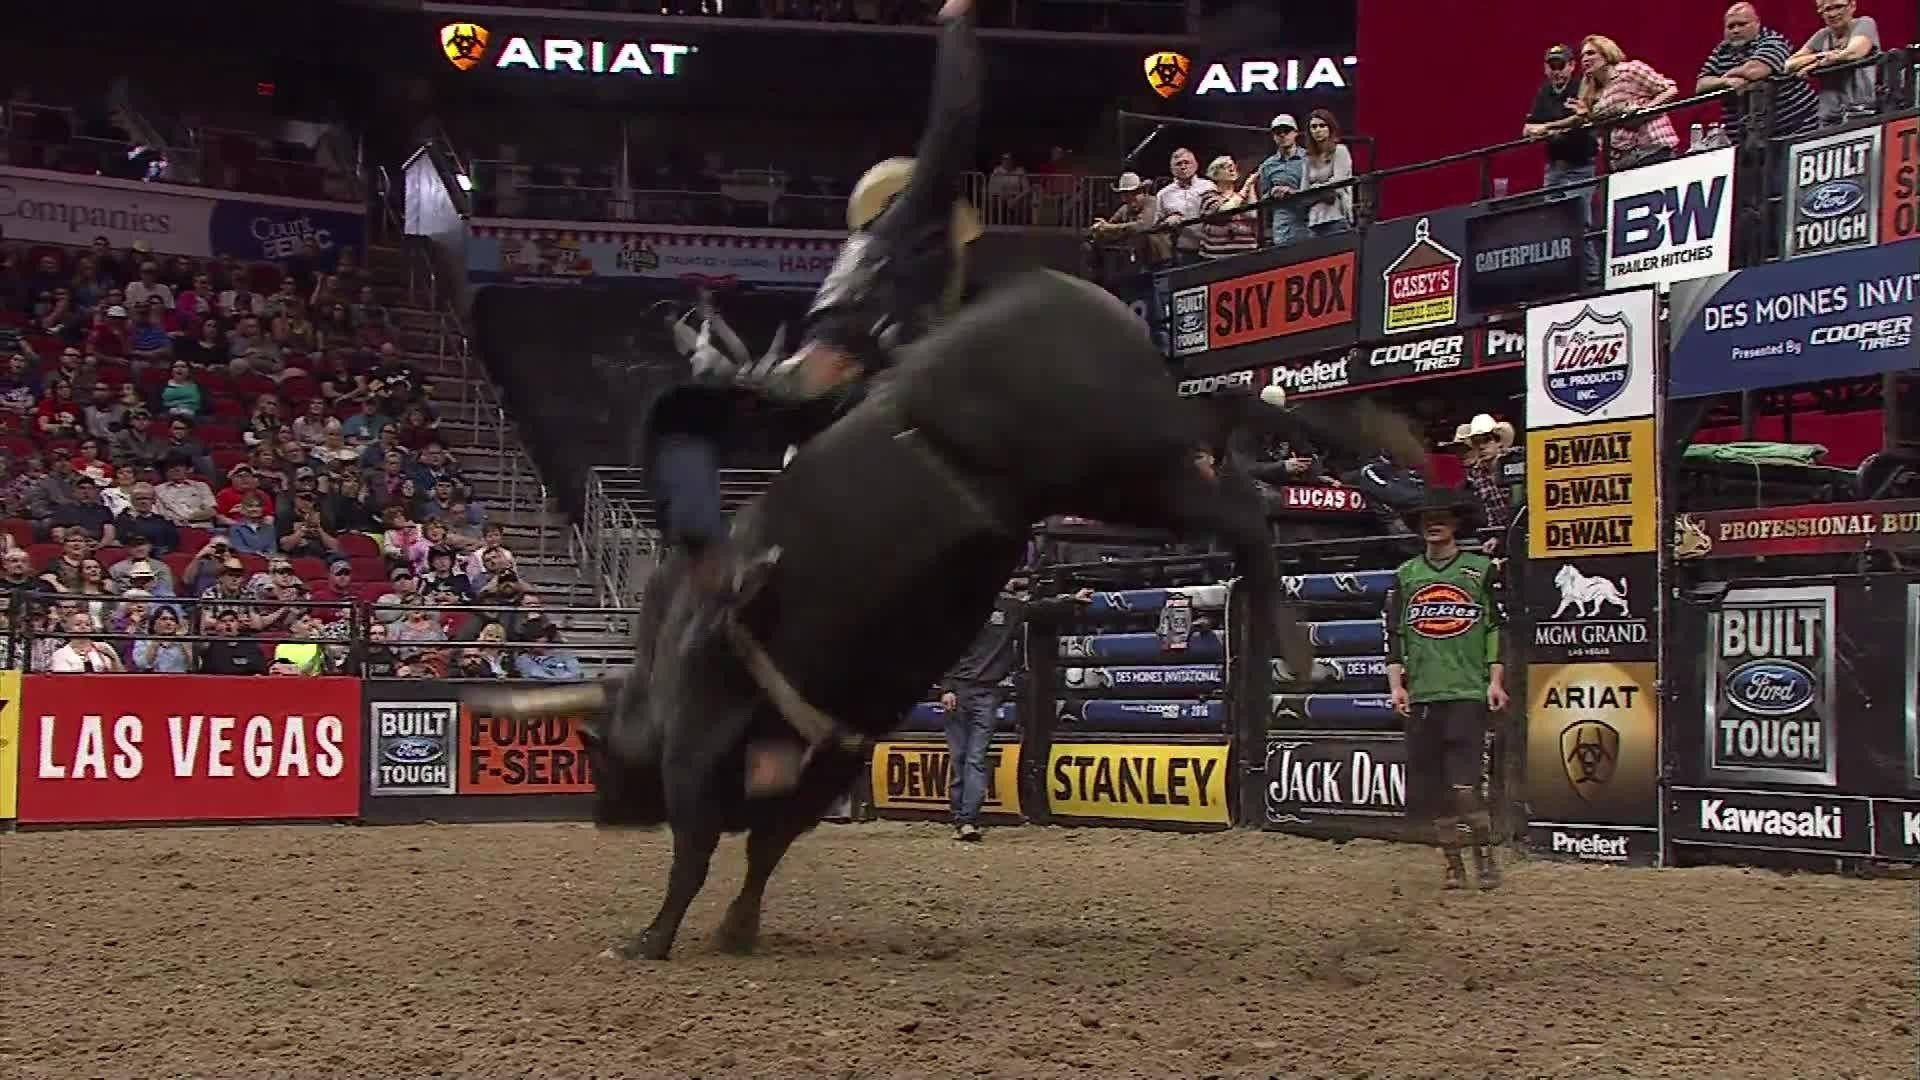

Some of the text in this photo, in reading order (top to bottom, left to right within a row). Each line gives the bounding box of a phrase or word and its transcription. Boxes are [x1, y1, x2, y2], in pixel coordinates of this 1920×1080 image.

[496, 38, 688, 75] ARIAT
[1196, 56, 1357, 95] ARIA
[1799, 143, 1870, 187] BUILT
[1797, 213, 1866, 248] TOUGH
[1476, 238, 1572, 273] CATERPILLAR
[1610, 246, 1713, 277] TRAILER HITCHES
[1393, 269, 1450, 299] CASEY'S
[1216, 281, 1275, 337] SKY
[1285, 264, 1347, 322] BOX
[1704, 302, 1748, 331] DES
[1756, 285, 1848, 324] MOINES
[1810, 315, 1912, 345] COOPER
[1859, 334, 1910, 351] TIRES
[1370, 335, 1464, 367] COOPER
[1413, 354, 1461, 372] TIRES
[1553, 341, 1622, 370] LUCAS
[1731, 340, 1801, 360] Presented By
[1272, 356, 1348, 388] Priefert
[1550, 370, 1624, 389] OIL PRODUCTS
[1289, 488, 1345, 508] LUCAS
[1720, 515, 1876, 541] PROFESSIONAL
[1409, 605, 1477, 620] Dickies
[1535, 624, 1645, 645] MGM GRAND
[1722, 608, 1821, 657] BUILT
[1116, 671, 1221, 682] DES MOINES INVITATIONAL
[1348, 664, 1372, 677] DES
[1745, 672, 1795, 700] Ford
[1543, 685, 1640, 709] ARIAT
[382, 712, 448, 736] BUILT
[470, 712, 568, 747] FORD
[39, 715, 343, 778] LAS VEGAS
[1720, 720, 1821, 760] TOUGH
[380, 765, 447, 784] TOUGH
[470, 750, 592, 784] F-SERI
[888, 753, 1001, 799] DEWT
[1054, 756, 1218, 806] STANLEY
[1269, 750, 1342, 803] JACK
[1699, 799, 1842, 839] Kawasaki
[1553, 831, 1628, 856] Priefert
